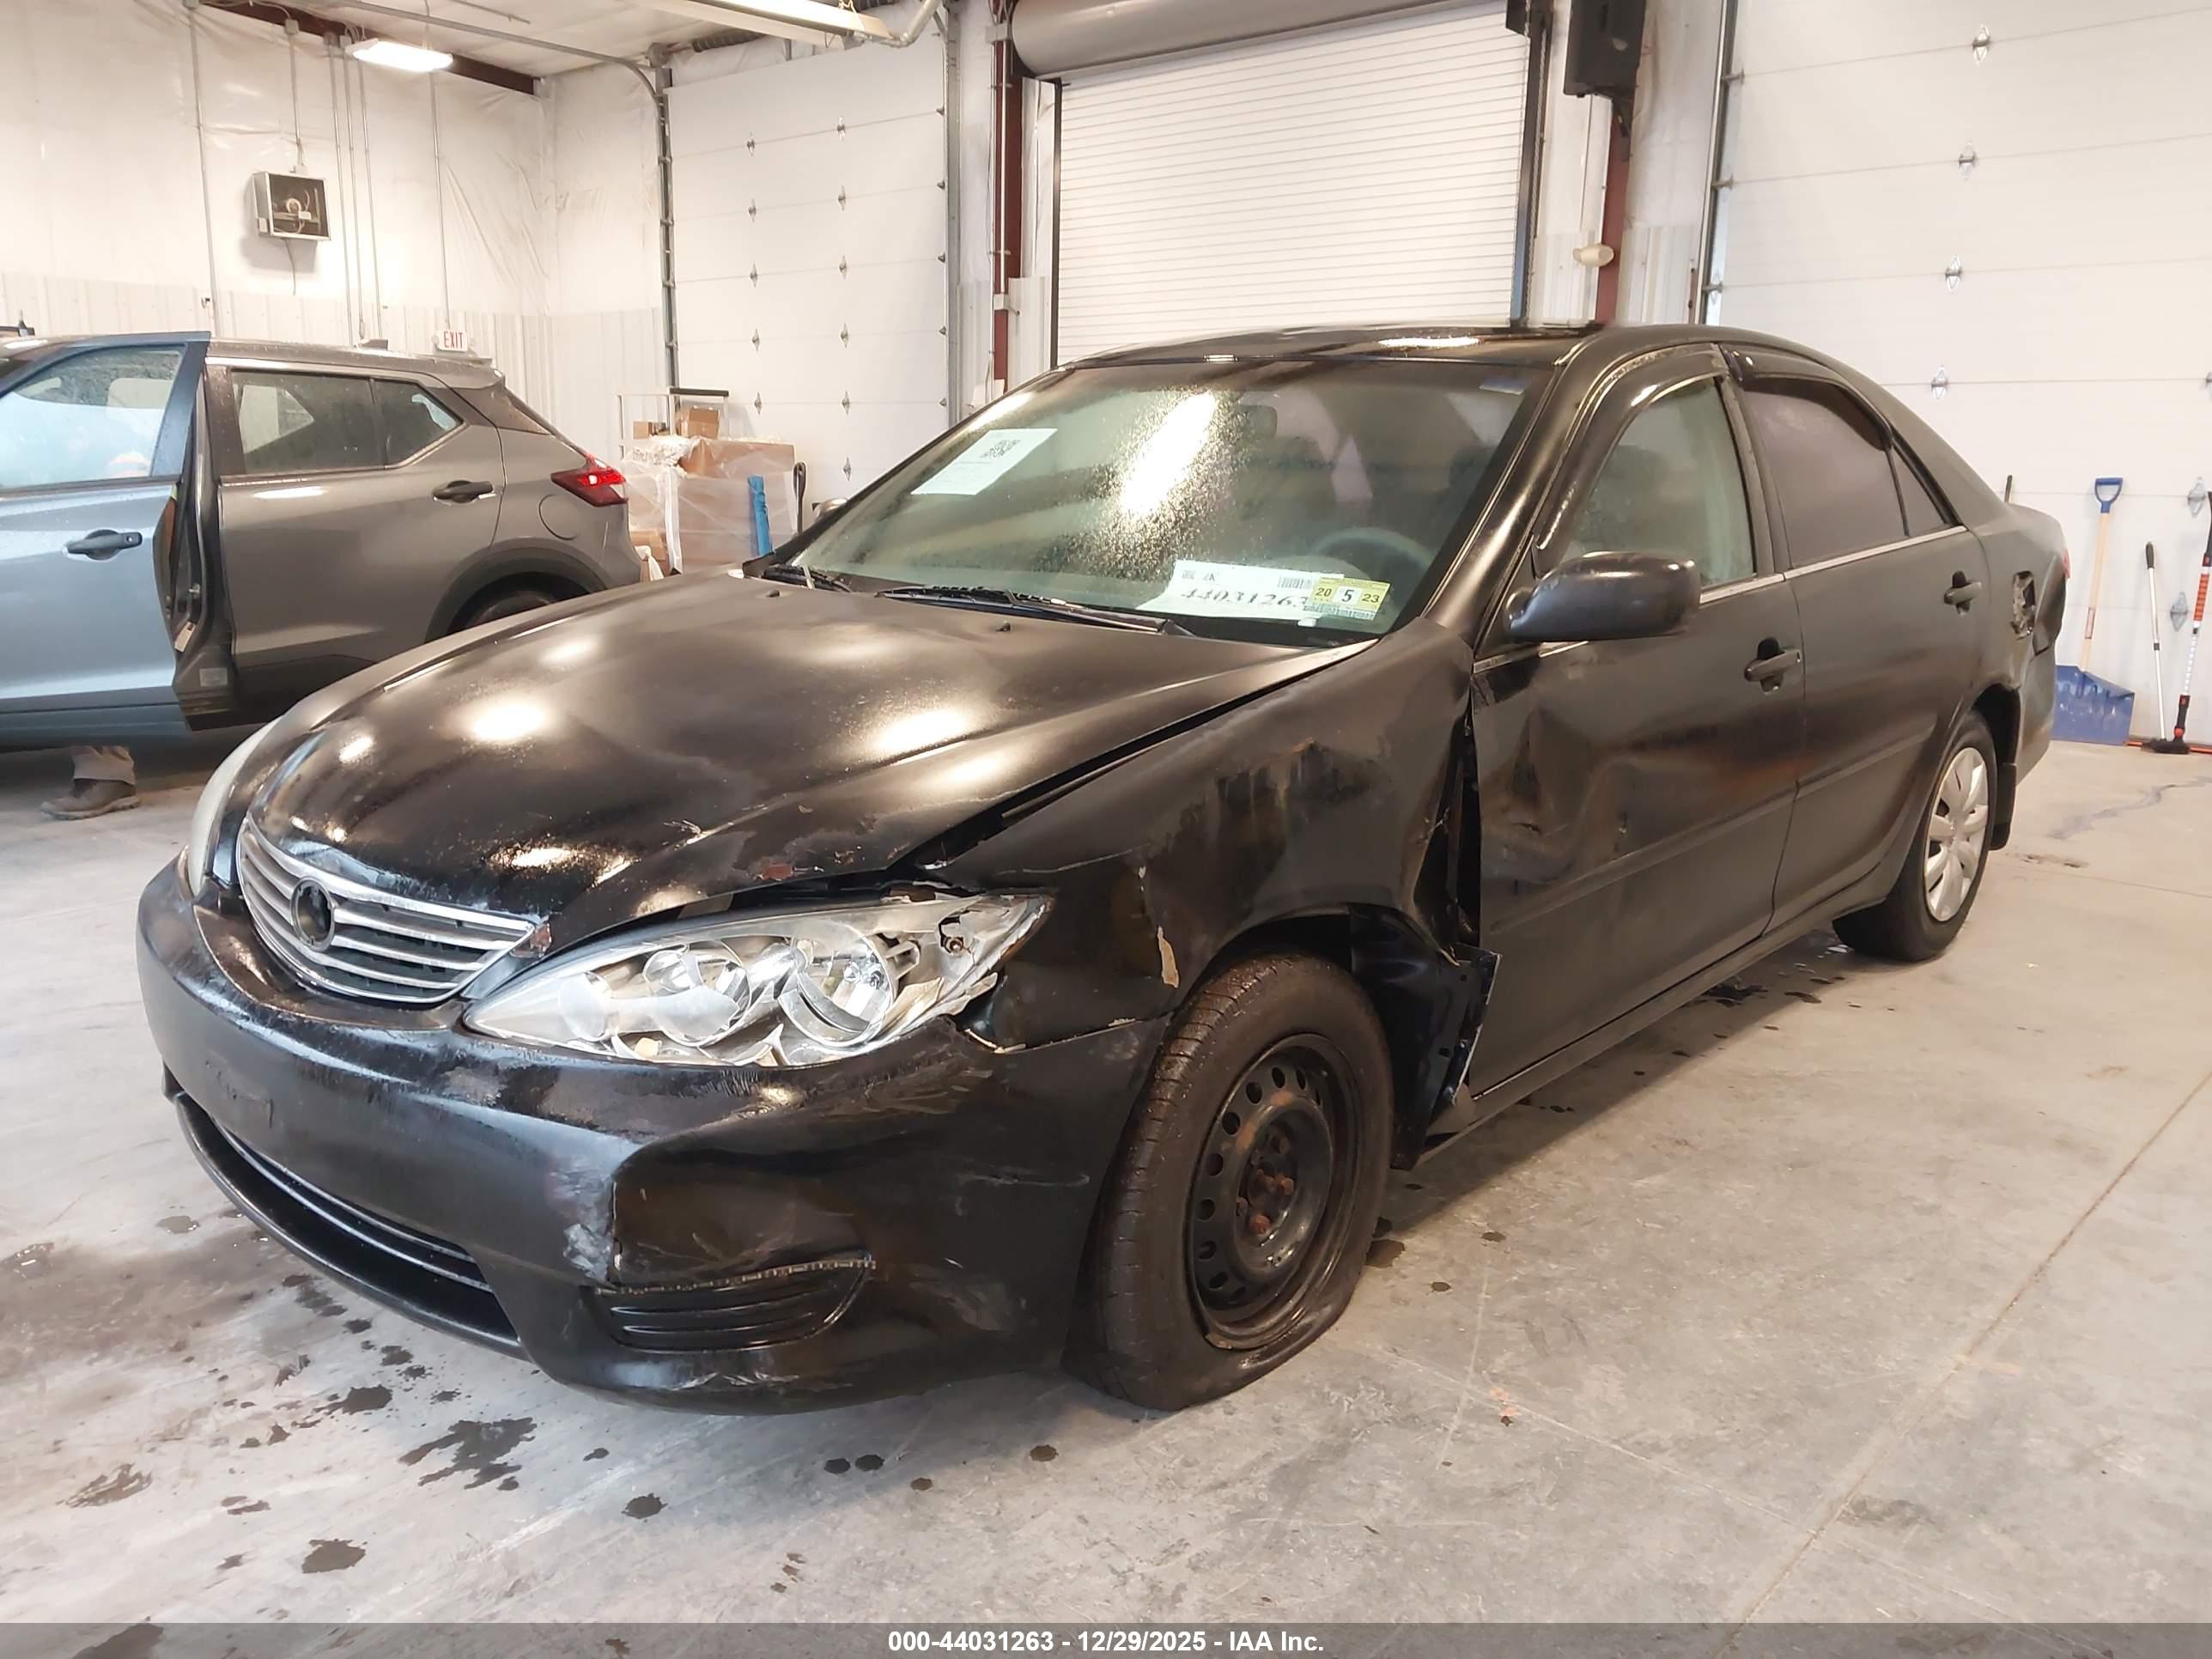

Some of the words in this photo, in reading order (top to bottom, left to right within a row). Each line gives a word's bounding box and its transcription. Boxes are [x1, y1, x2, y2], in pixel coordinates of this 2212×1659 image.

[443, 331, 464, 349] EXIT
[1315, 587, 1333, 598] 20
[1341, 589, 1354, 603] 5
[1361, 593, 1380, 604] 23
